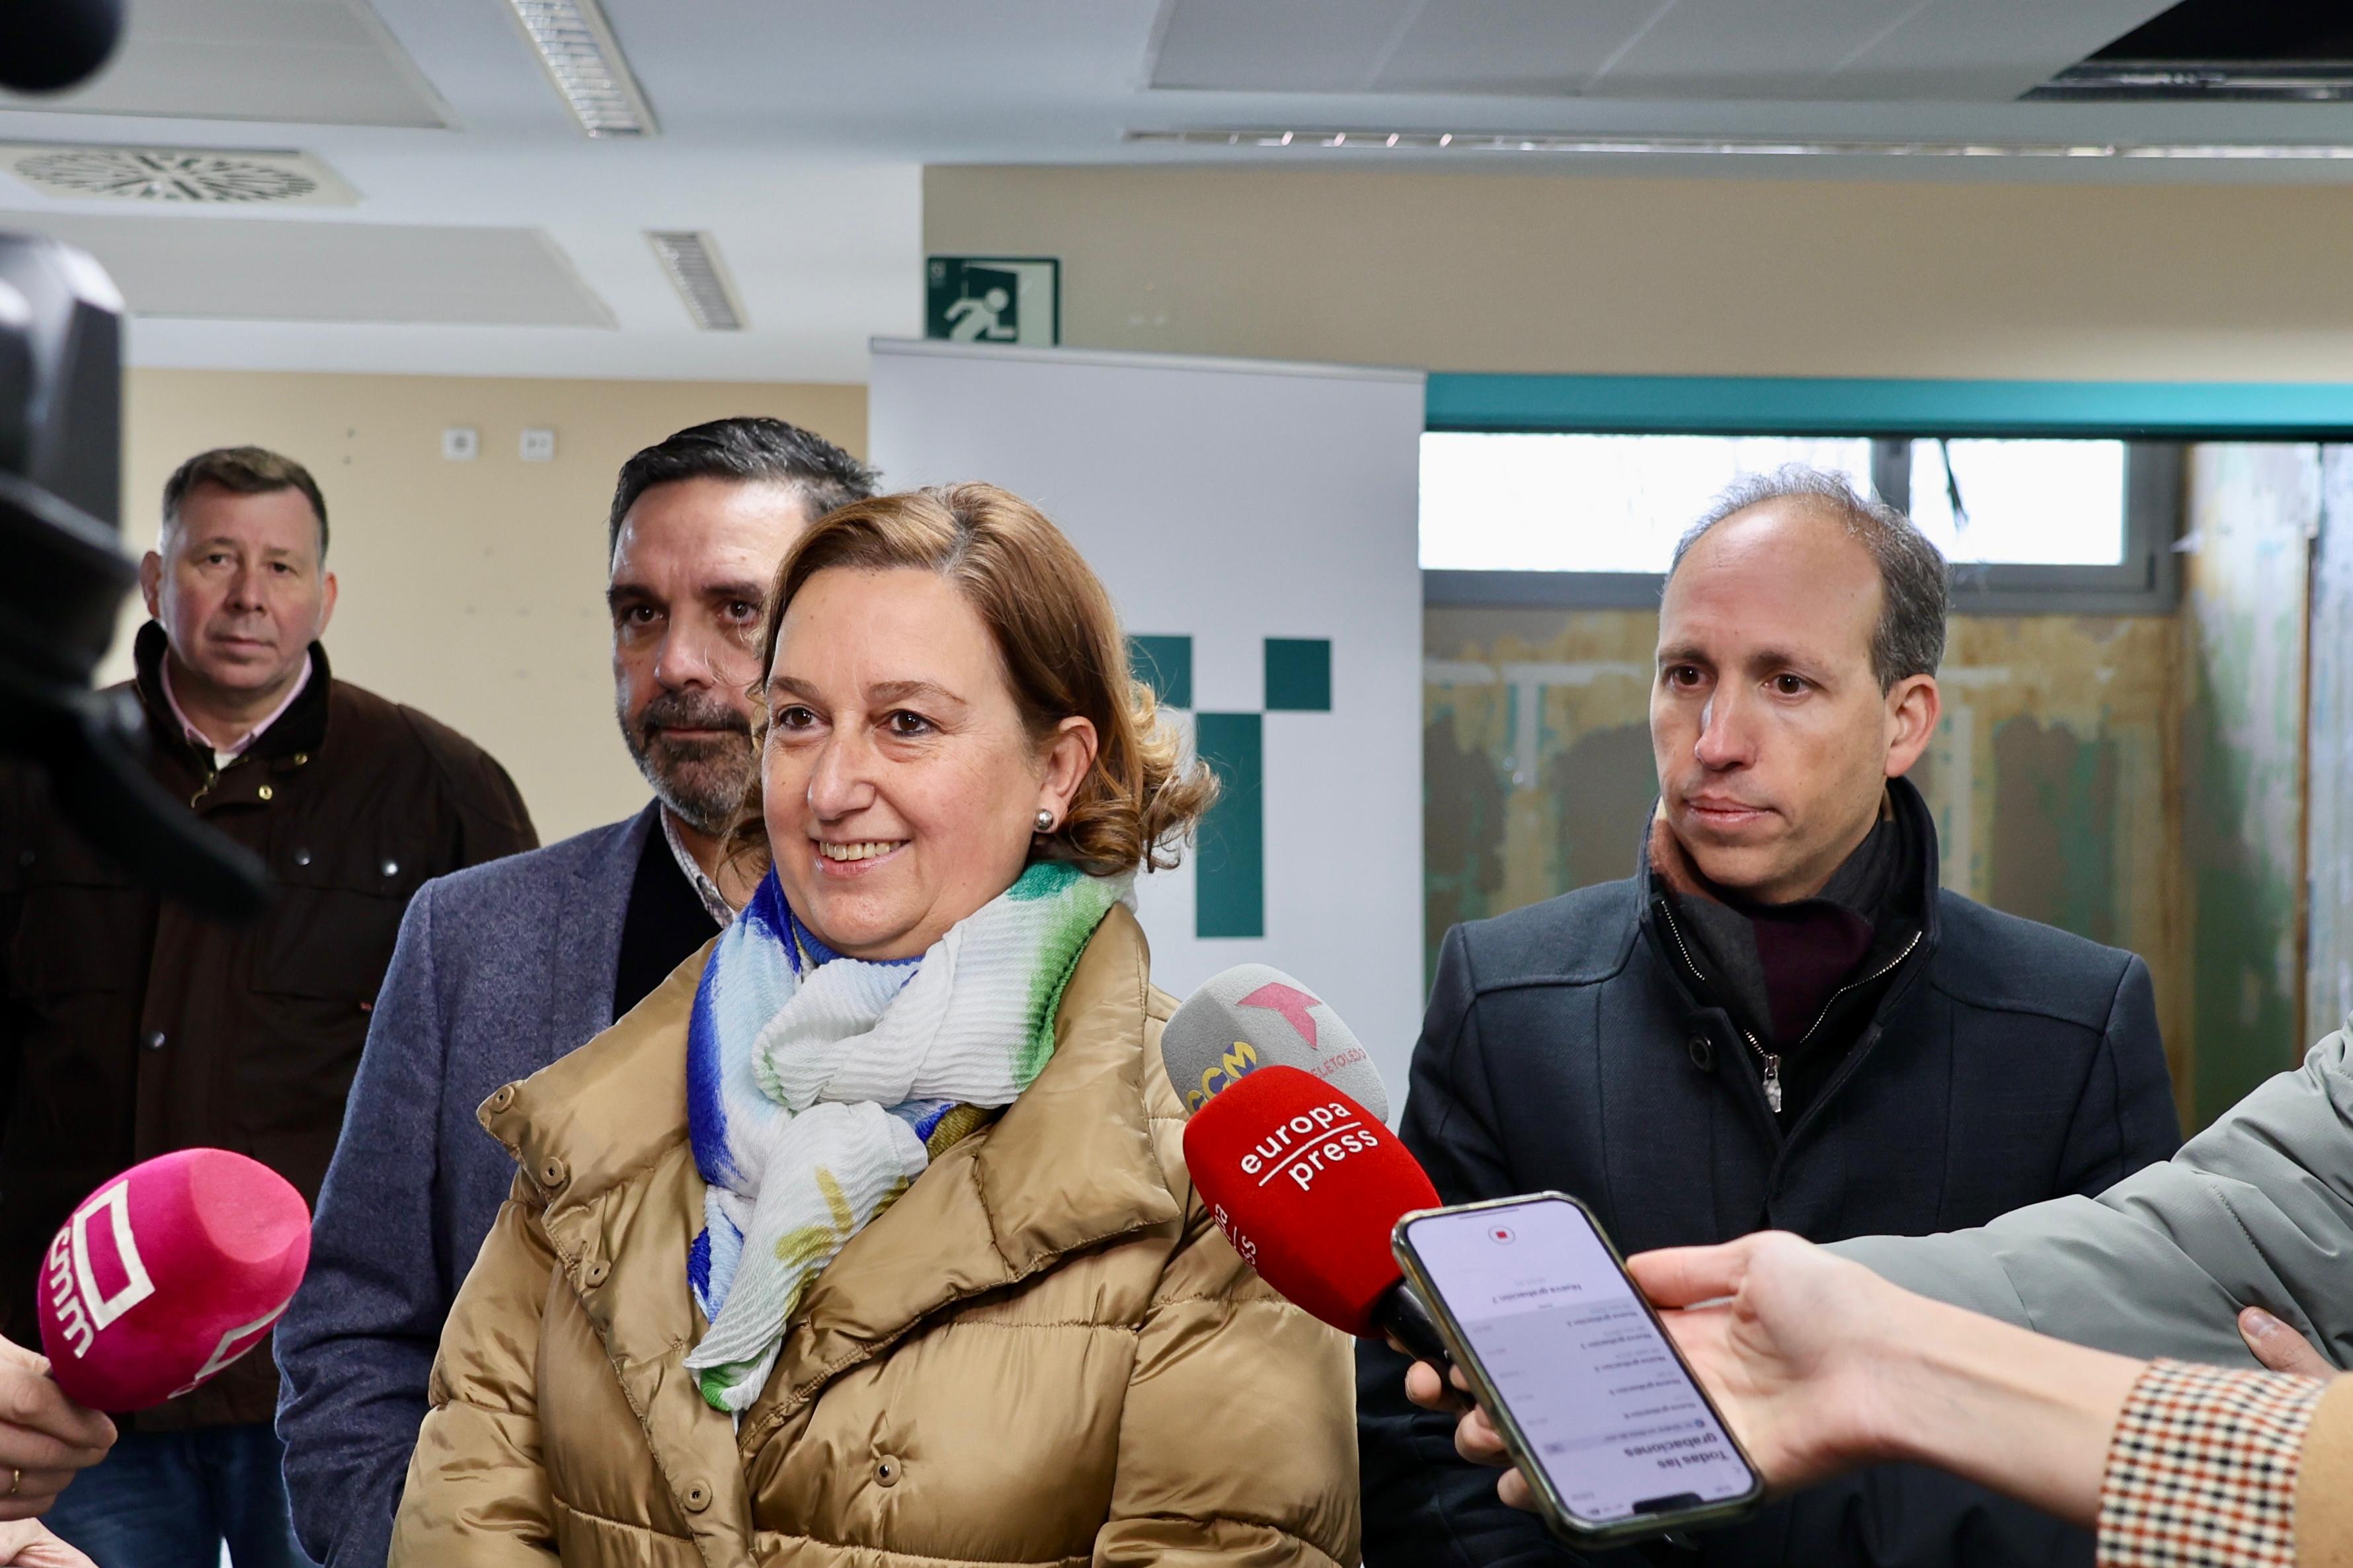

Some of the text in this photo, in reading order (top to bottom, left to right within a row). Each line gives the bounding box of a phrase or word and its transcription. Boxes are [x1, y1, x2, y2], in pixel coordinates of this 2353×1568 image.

[1241, 1103, 1352, 1174] europa
[1288, 1130, 1378, 1191] press
[50, 1226, 94, 1359] cmm
[1624, 1432, 1718, 1457] grabaciones
[1657, 1450, 1730, 1469] Todas las
